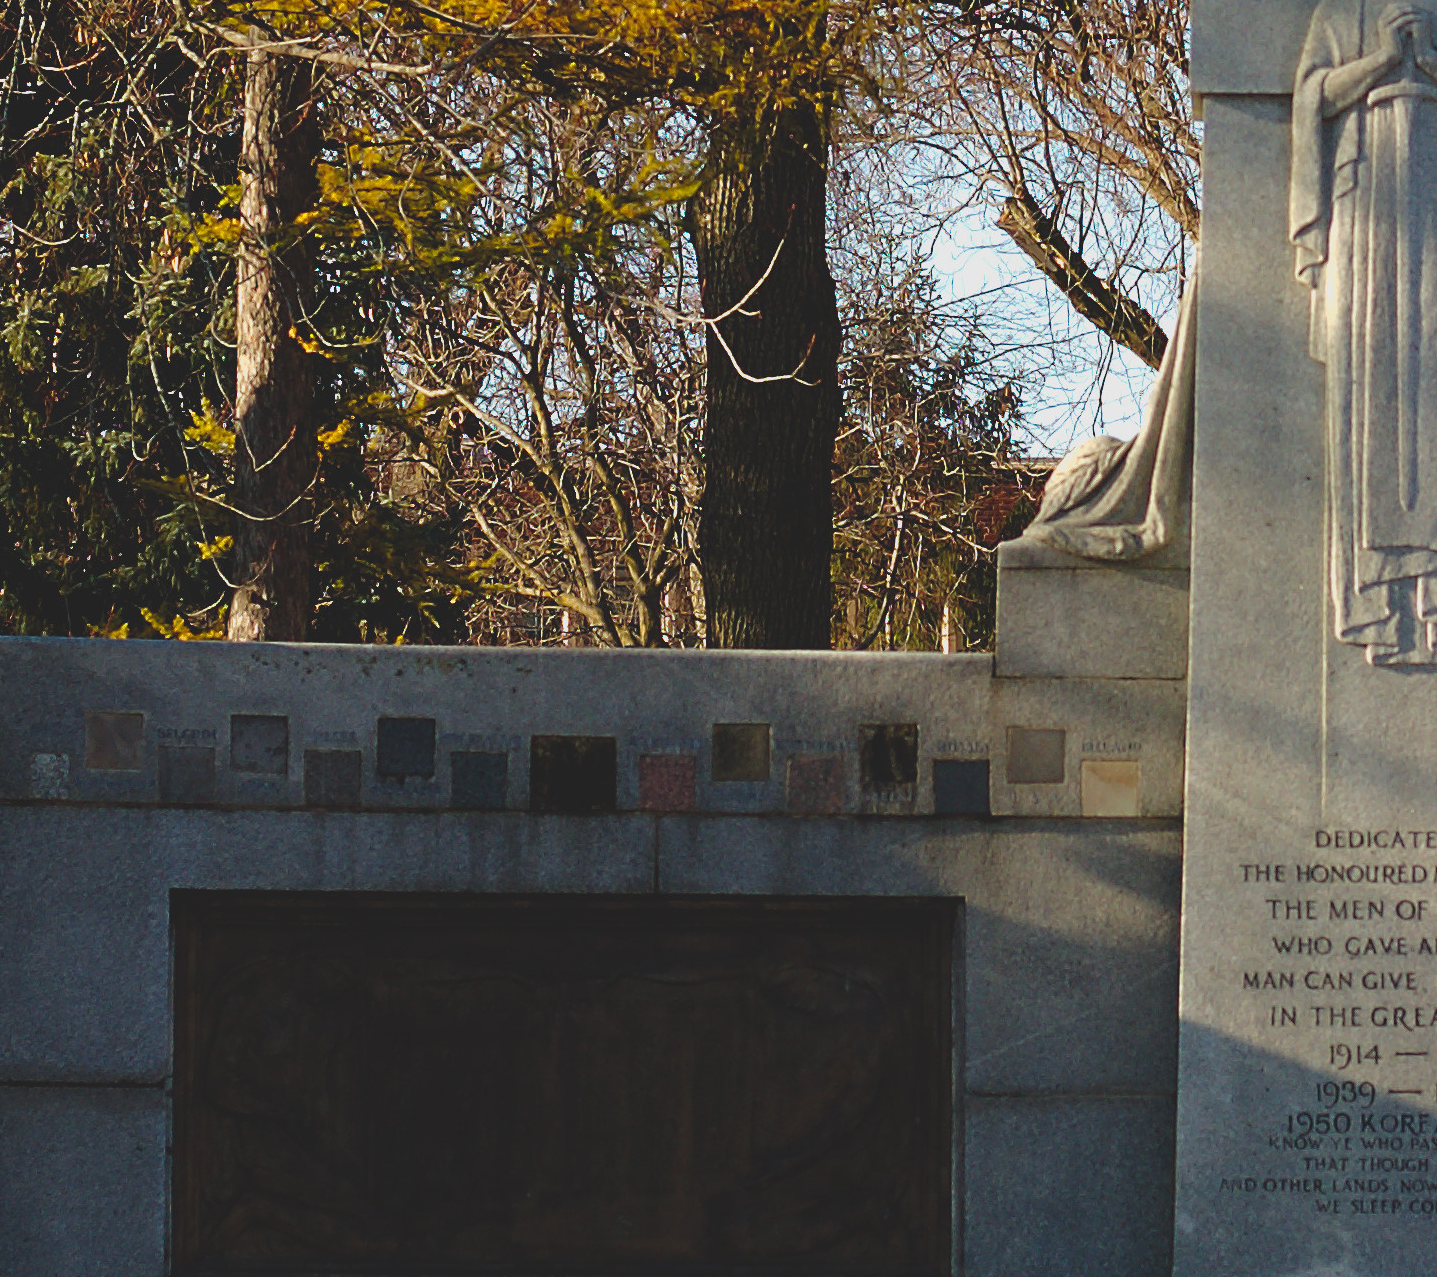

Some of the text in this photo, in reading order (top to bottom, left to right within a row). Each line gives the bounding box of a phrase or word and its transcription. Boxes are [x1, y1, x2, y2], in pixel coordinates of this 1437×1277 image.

[1239, 865, 1287, 884] THE
[1296, 864, 1428, 886] HONOURED
[1265, 899, 1318, 922] THE
[1328, 899, 1386, 922] MEN
[1395, 899, 1429, 921] OF
[1271, 936, 1332, 956] WHO
[1344, 935, 1408, 956] GAVE
[1242, 971, 1295, 990] MAN
[1304, 971, 1354, 990] CAN
[1270, 1006, 1297, 1028] IN
[1310, 1006, 1362, 1028] THE
[1329, 1043, 1382, 1070] 1914
[1316, 1081, 1376, 1108] 1939
[1287, 1111, 1351, 1136] 1950
[1268, 1136, 1322, 1151] KNOW
[1360, 1136, 1403, 1151] WHO
[1303, 1156, 1349, 1172] THAT
[1358, 1156, 1429, 1172] THOUGH
[1219, 1177, 1257, 1193] AND
[1263, 1177, 1325, 1194] OTHER
[1332, 1177, 1389, 1193] LANDS
[1315, 1198, 1339, 1213] WE
[1351, 1198, 1402, 1214] SLEEP
